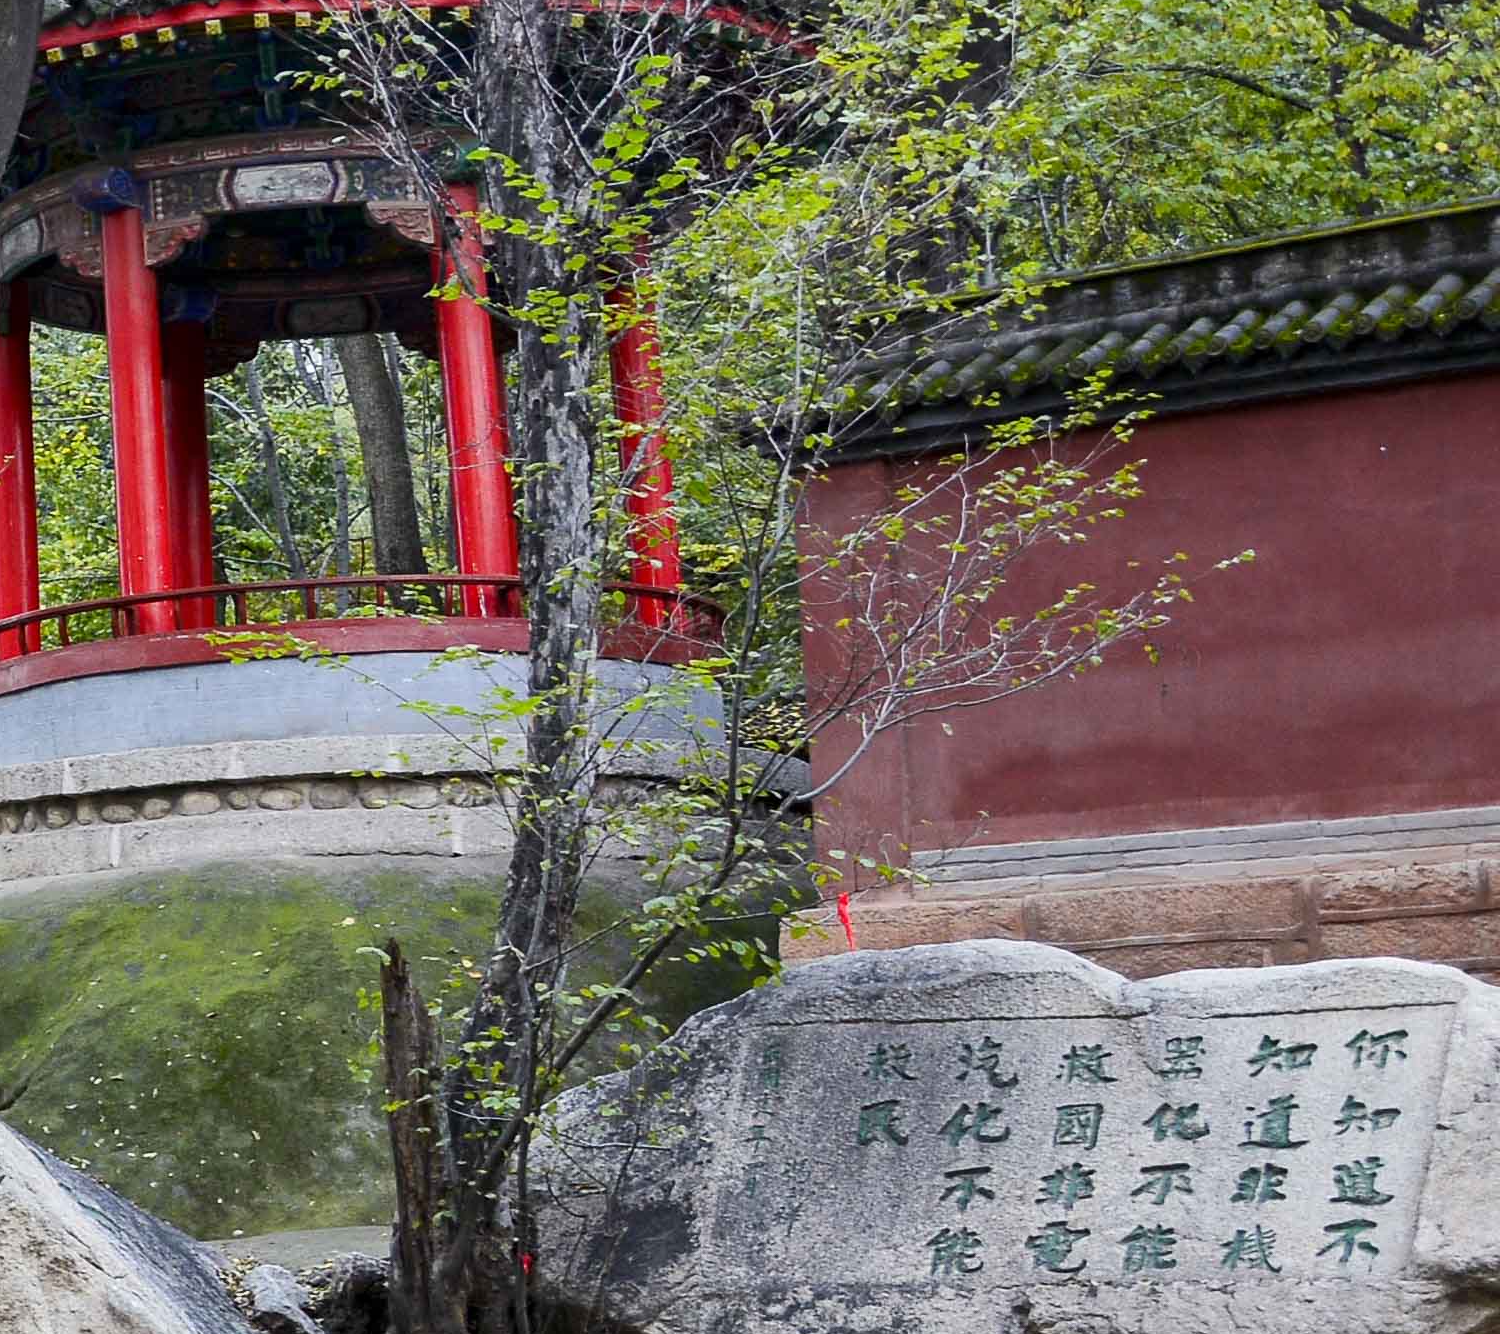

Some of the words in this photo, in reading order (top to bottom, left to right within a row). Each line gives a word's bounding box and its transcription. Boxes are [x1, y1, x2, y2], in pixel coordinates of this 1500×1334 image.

[925, 1035, 1020, 1276] 汽化不能
[1116, 1035, 1211, 1275] 器化不能
[1315, 1028, 1409, 1265] 你知道不
